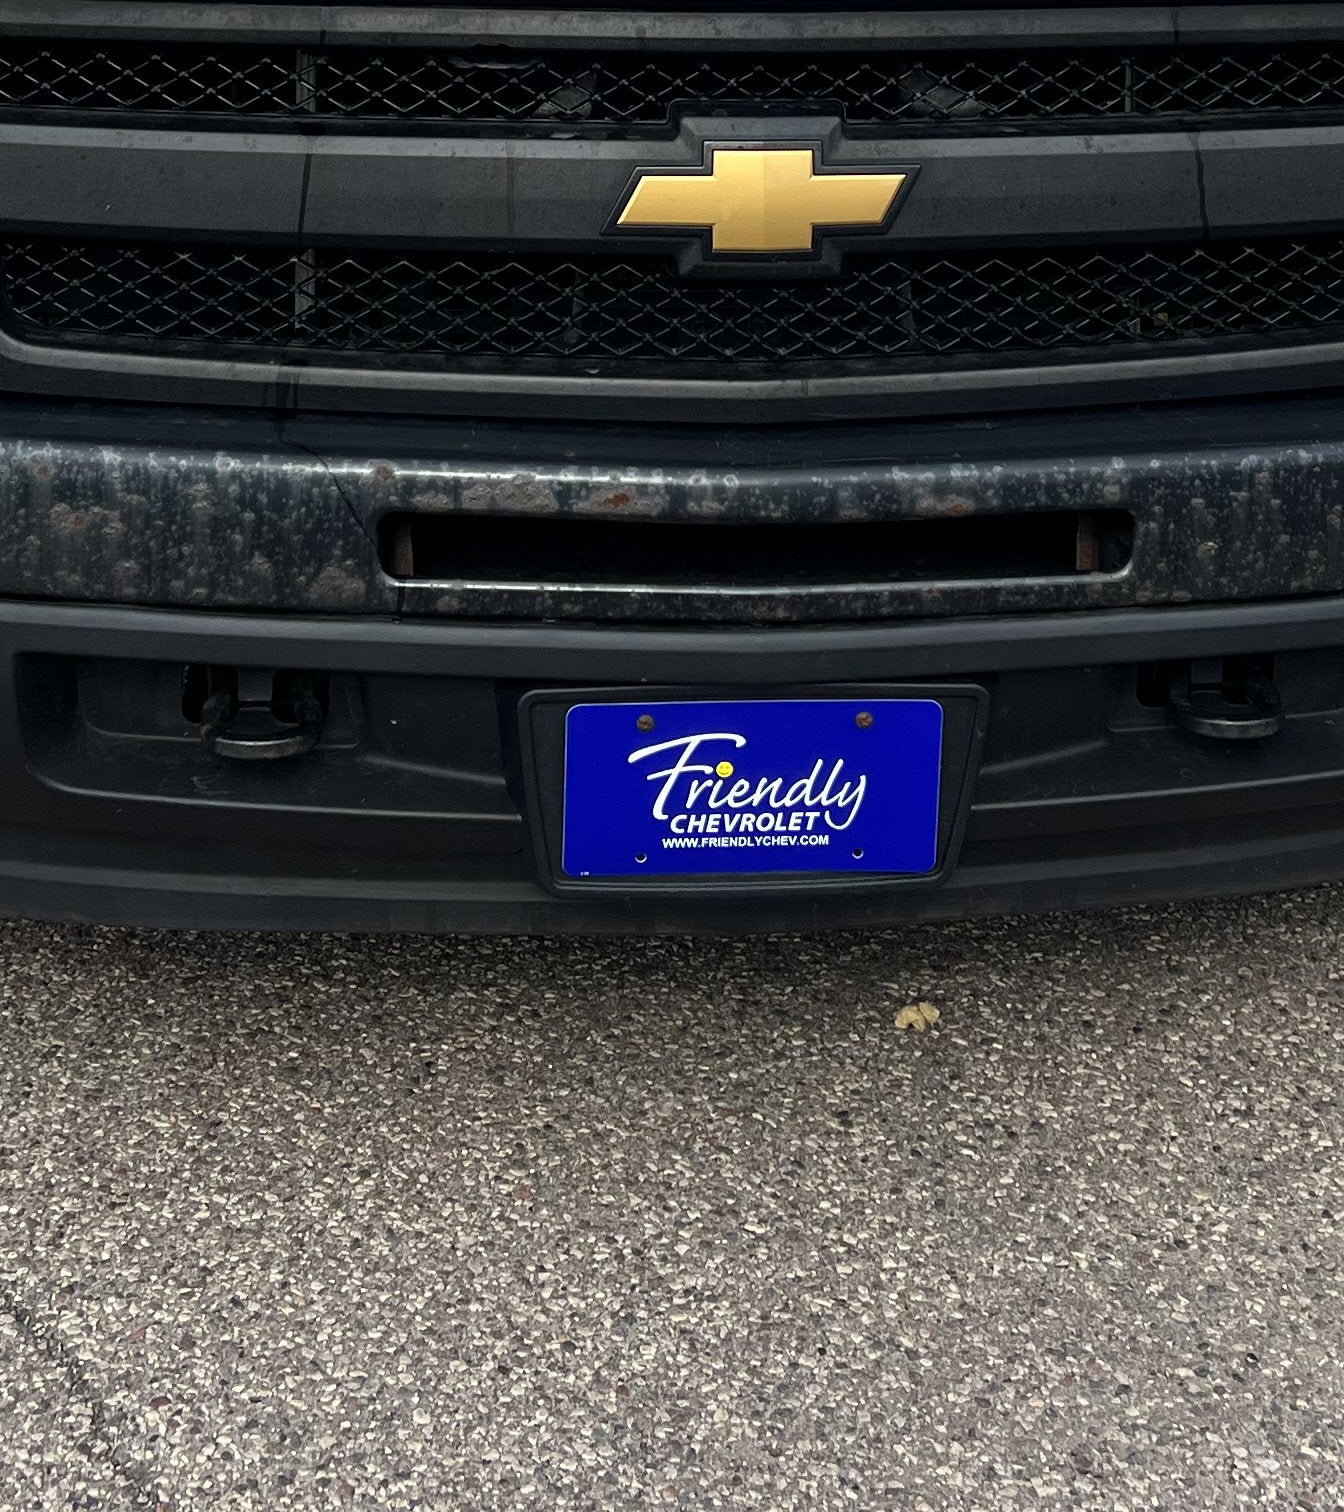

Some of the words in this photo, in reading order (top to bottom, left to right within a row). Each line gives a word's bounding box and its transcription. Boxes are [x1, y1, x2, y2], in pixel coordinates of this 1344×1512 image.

[627, 732, 867, 830] Friendly
[670, 811, 821, 834] CHEVROLET
[661, 834, 830, 849] WWW.FRIENDLYCHEV.COM
